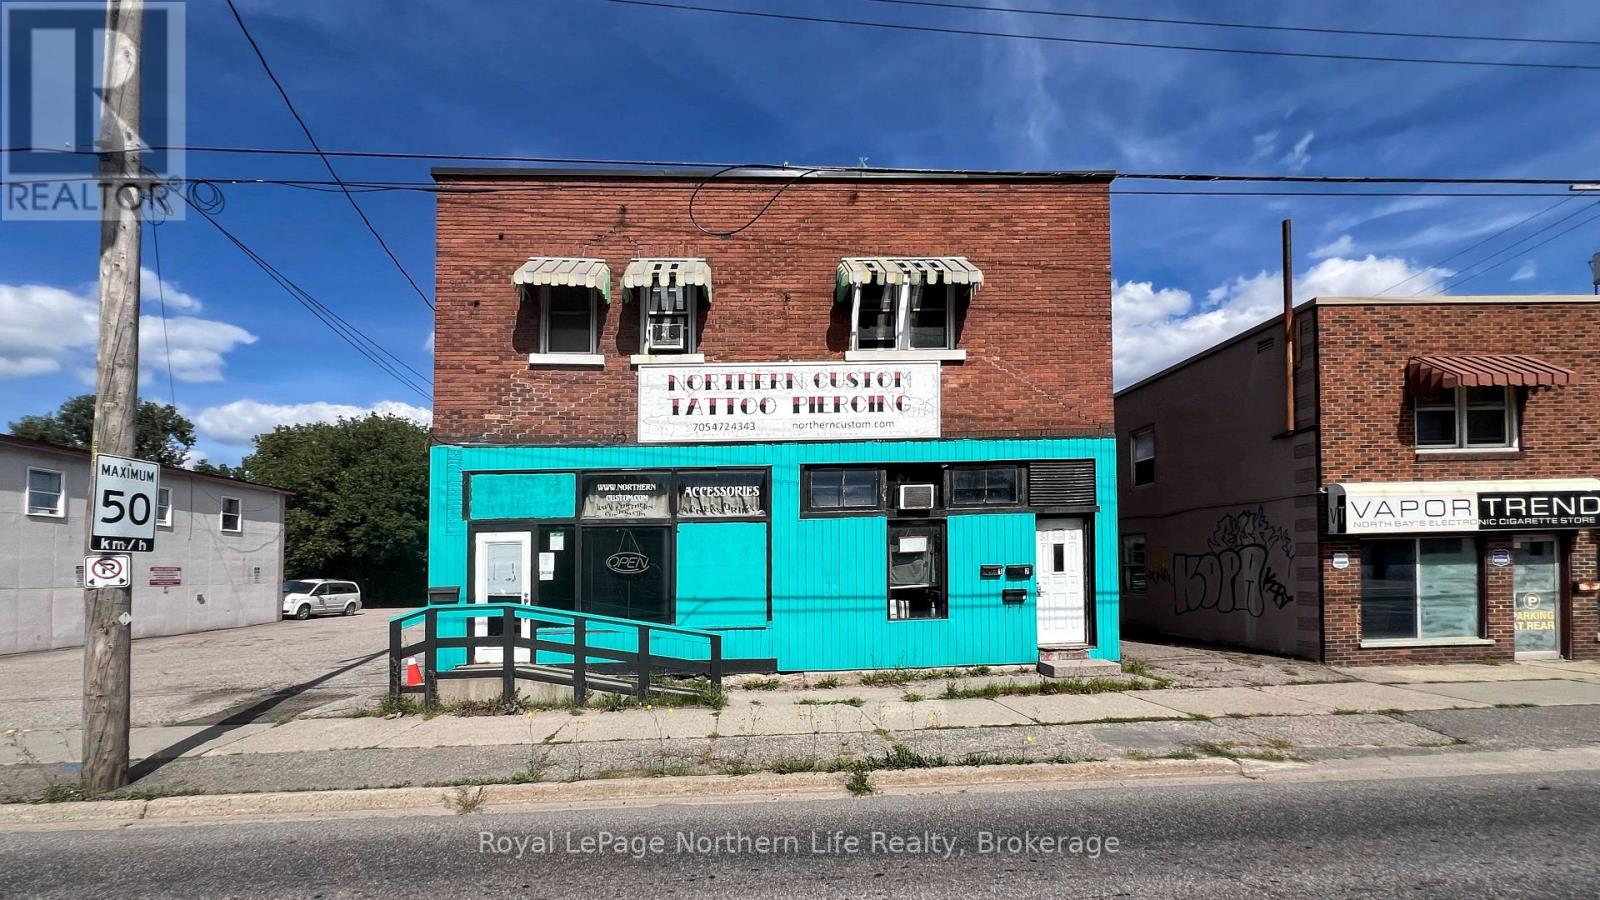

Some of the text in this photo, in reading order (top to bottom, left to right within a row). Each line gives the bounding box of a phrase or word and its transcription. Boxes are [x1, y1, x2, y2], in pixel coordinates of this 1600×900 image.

[668, 371, 912, 391] NORTHERN CUSTOM
[667, 395, 912, 416] TATTOO PIERCING
[693, 419, 895, 432] 7054724343 northerncustom.com
[101, 464, 155, 483] MAXIMUM
[597, 483, 657, 492] WWW.NORTHERN
[683, 485, 760, 498] ACCESSORIES
[606, 494, 649, 502] CUSTOM.COM
[101, 489, 151, 526] 50
[1350, 499, 1472, 519] VAPOR
[1353, 516, 1595, 528] NORTH BAY'S ELECTRONIC CIGARETTE STORE
[608, 556, 649, 569] OPEN
[1527, 596, 1538, 606] P
[1527, 621, 1554, 630] REAR
